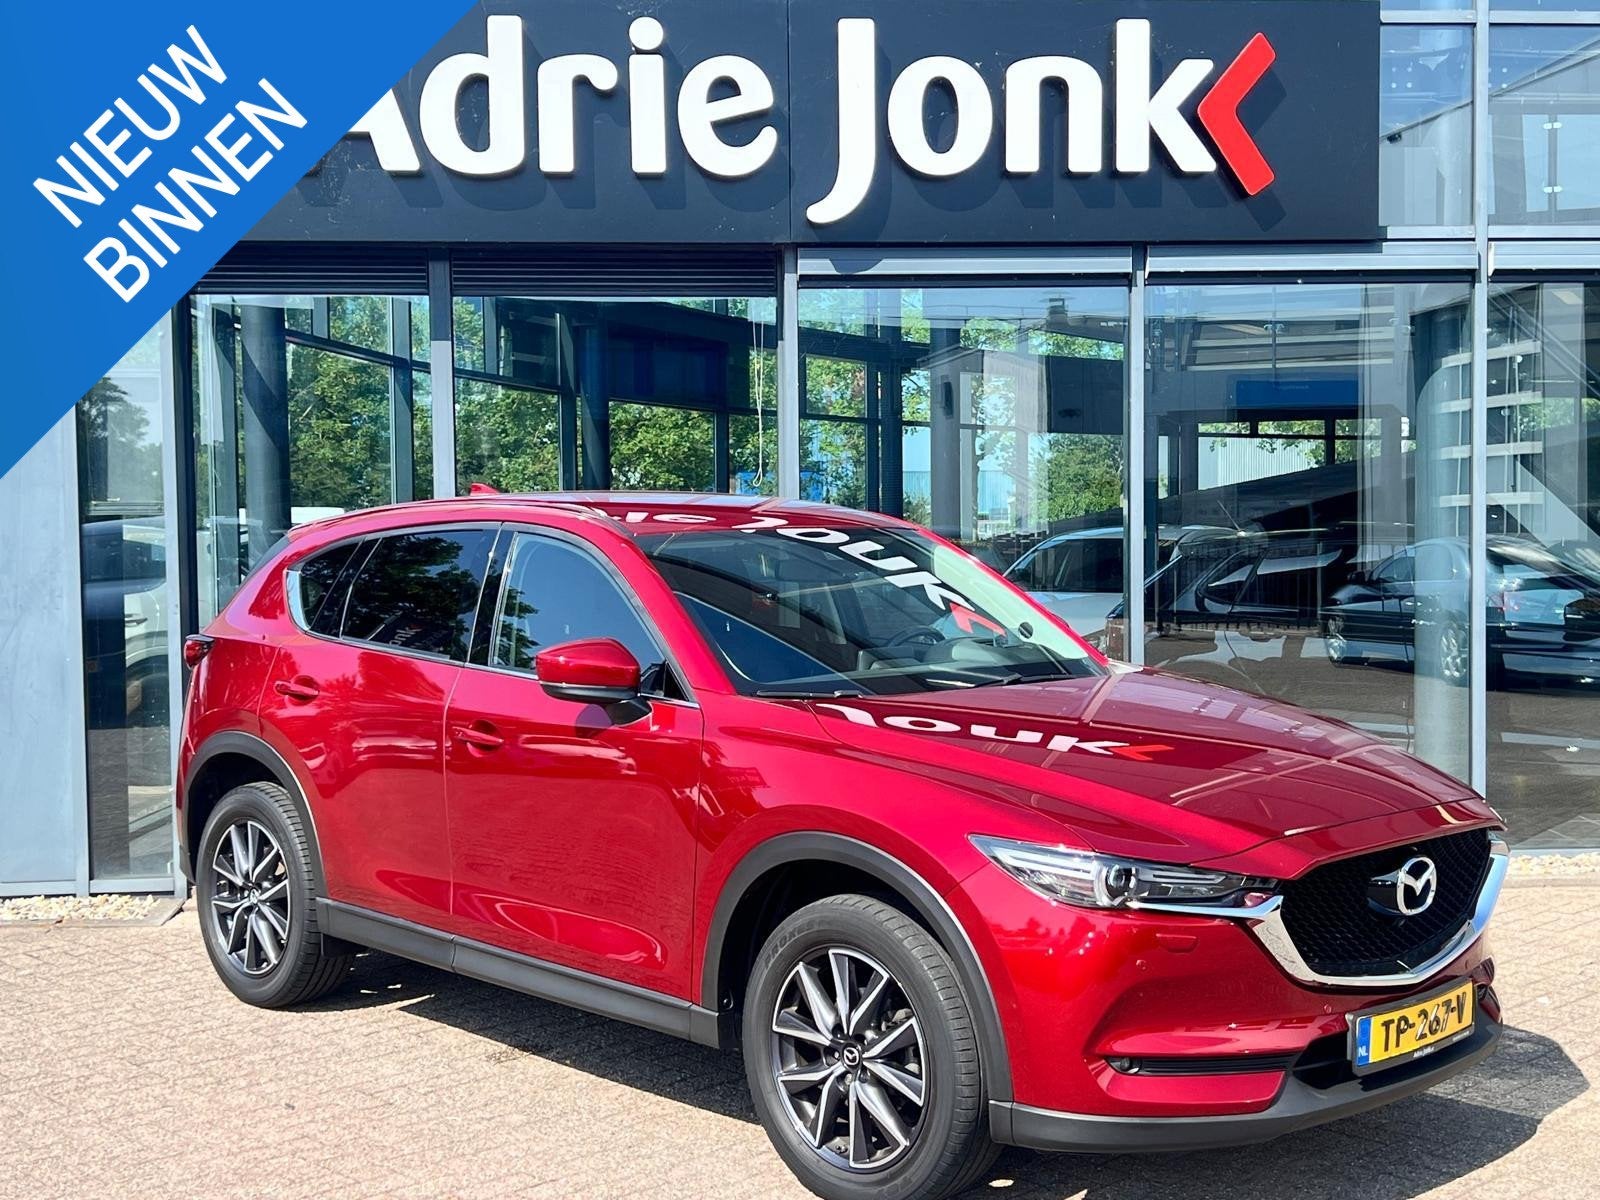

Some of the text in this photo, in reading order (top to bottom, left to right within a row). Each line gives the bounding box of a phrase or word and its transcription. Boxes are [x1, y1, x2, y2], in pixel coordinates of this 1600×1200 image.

[806, 19, 1216, 223] Jonk
[1358, 1045, 1369, 1058] NL
[1381, 991, 1467, 1052] TP-267-V
